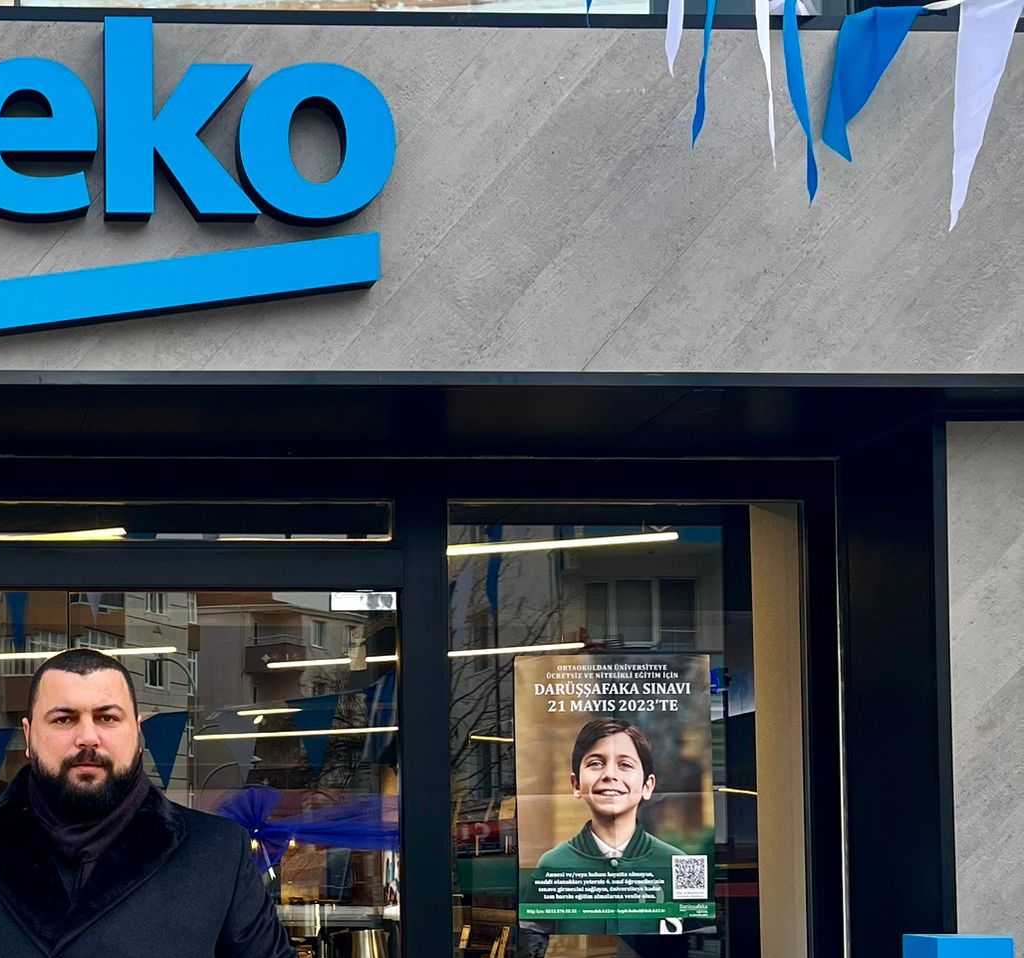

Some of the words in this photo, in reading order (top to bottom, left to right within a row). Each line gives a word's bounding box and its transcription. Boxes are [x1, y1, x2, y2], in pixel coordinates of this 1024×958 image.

[534, 681, 640, 698] DARÜŞŞAFAKA
[642, 682, 691, 695] SINAVI
[547, 700, 566, 713] 21
[570, 700, 616, 712] MAYIS
[618, 698, 679, 712] 2023'TE
